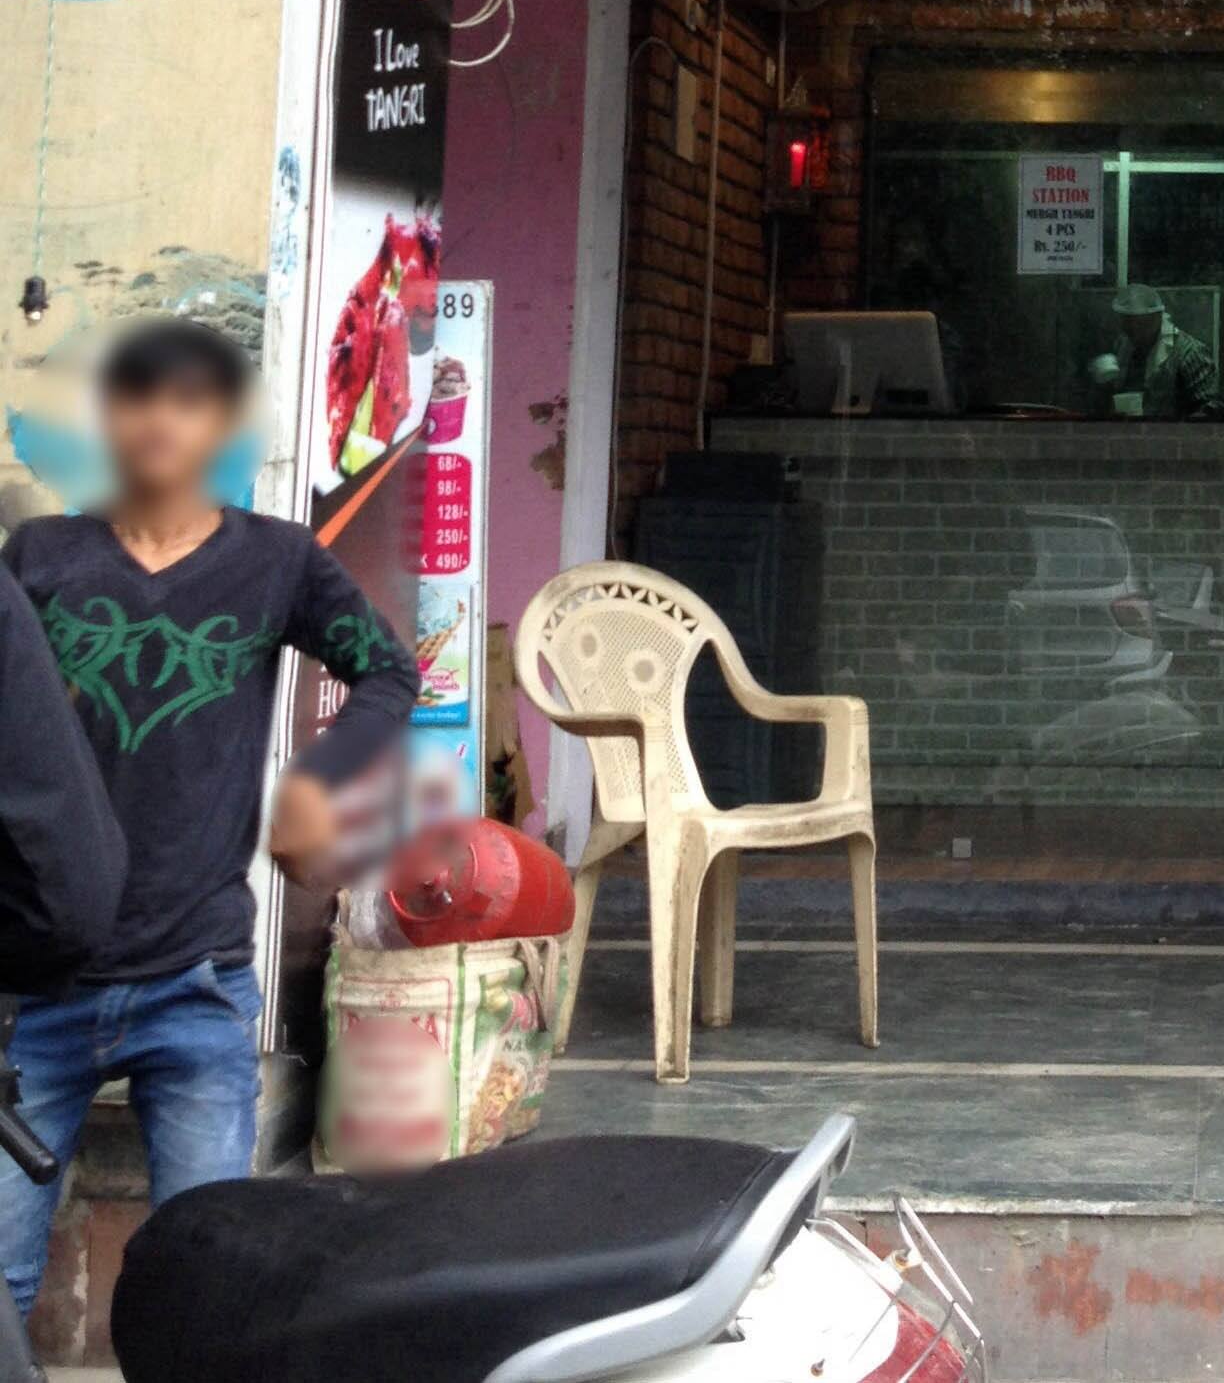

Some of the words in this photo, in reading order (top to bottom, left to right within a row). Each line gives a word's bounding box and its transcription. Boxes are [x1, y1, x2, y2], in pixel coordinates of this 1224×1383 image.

[373, 28, 384, 72] I
[385, 28, 421, 72] Love
[1046, 166, 1076, 182] BBQ
[1033, 188, 1090, 204] STATION
[435, 293, 476, 318] 89
[436, 553, 469, 569] 490/-
[317, 677, 350, 719] HO
